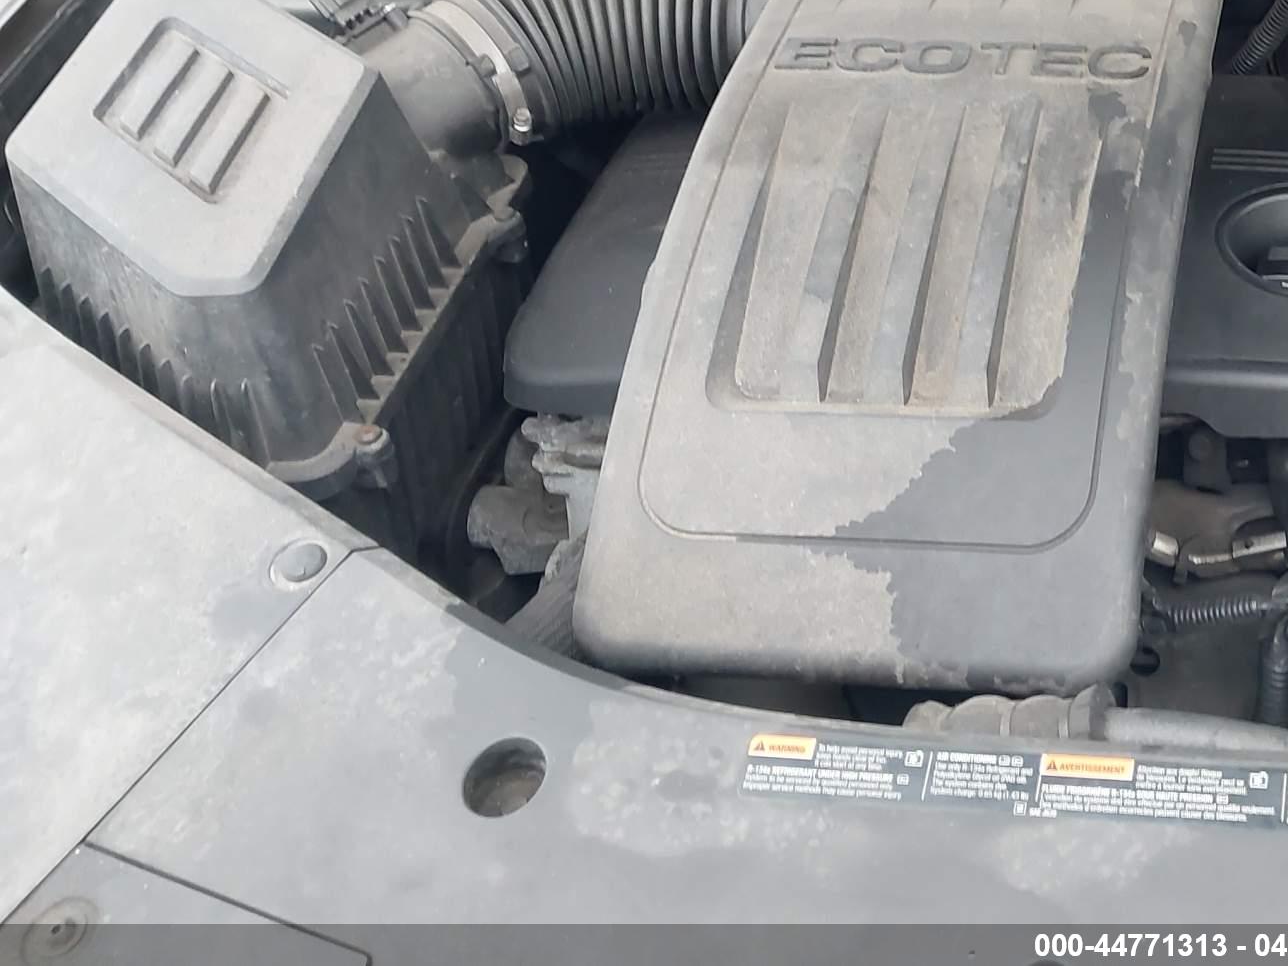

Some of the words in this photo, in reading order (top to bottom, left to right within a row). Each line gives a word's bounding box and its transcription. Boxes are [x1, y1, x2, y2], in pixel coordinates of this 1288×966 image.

[774, 36, 1152, 80] ECOTEC
[769, 745, 807, 754] WARNING
[1059, 762, 1126, 774] AVERTISSEMENT
